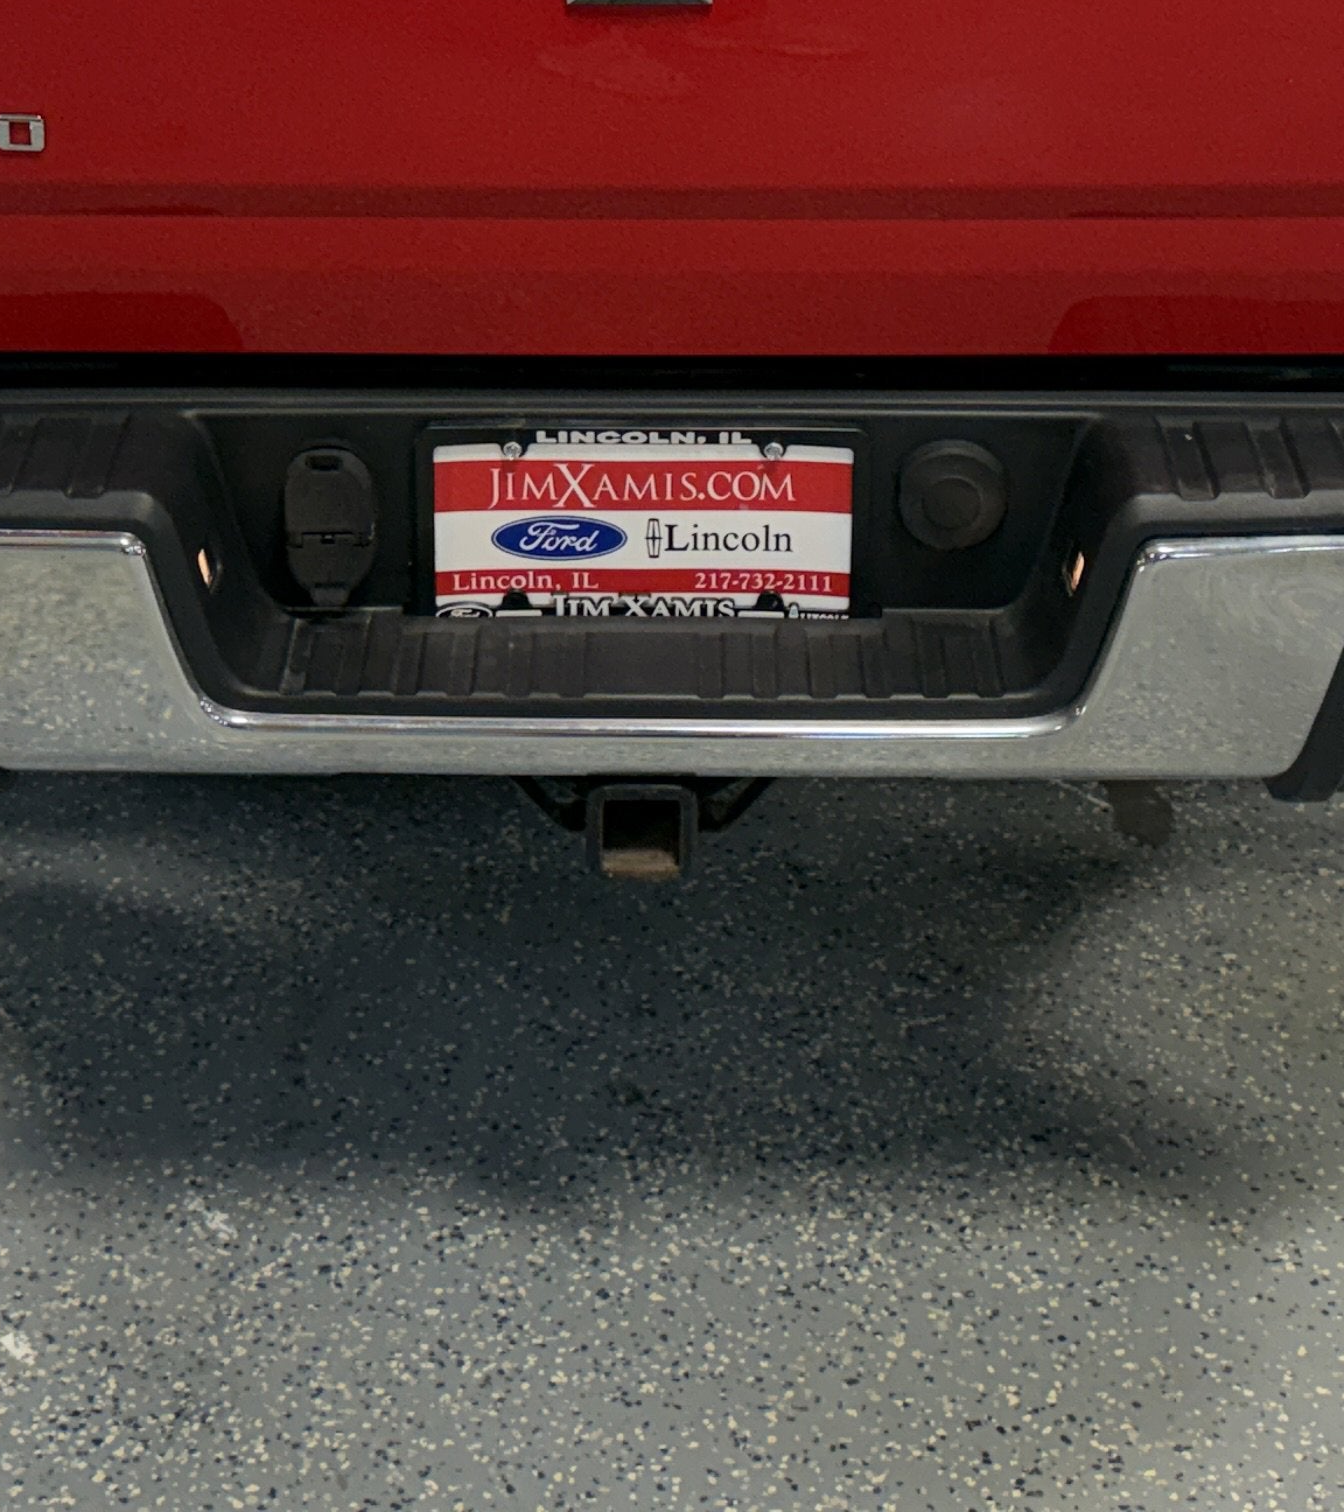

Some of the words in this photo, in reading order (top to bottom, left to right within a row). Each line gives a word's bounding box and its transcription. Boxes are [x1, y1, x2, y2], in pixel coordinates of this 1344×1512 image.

[718, 430, 753, 445] IL
[519, 523, 600, 553] Ford
[664, 522, 794, 554] Lincoln
[452, 571, 562, 592] Lincoln,
[571, 571, 600, 589] IL
[694, 572, 833, 593] 217-732-2111
